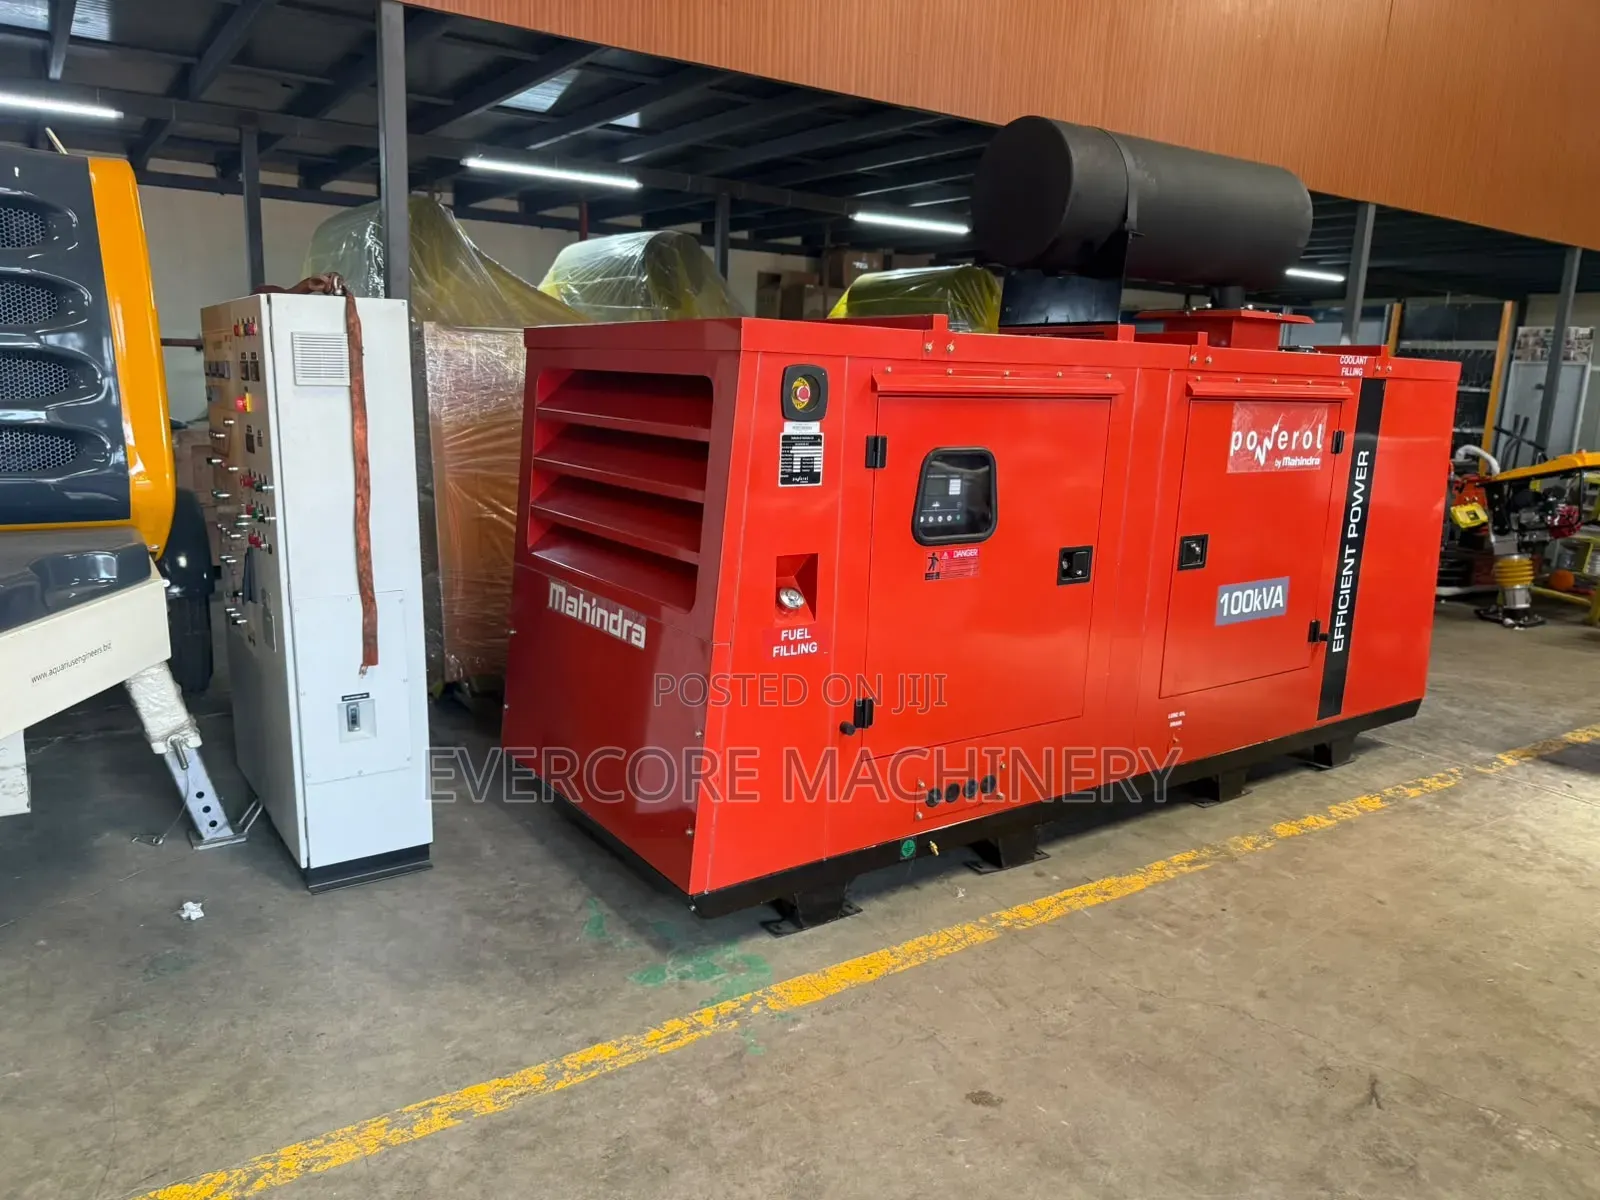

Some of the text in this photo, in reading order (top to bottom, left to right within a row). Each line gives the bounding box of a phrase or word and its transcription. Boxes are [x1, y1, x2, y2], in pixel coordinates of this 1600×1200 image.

[1340, 355, 1368, 365] COOLANT
[1341, 367, 1363, 376] FILLING
[1230, 413, 1323, 466] powerol
[1275, 456, 1320, 469] by Mahindra
[953, 548, 979, 559] DANGER
[1332, 450, 1370, 653] EFFICIENT POWER
[1220, 585, 1284, 617] 100kVA
[548, 582, 646, 649] Mahindra
[781, 628, 812, 641] FUEL
[772, 642, 818, 658] FILLING
[31, 641, 112, 684] www.aquariusengineers.biz
